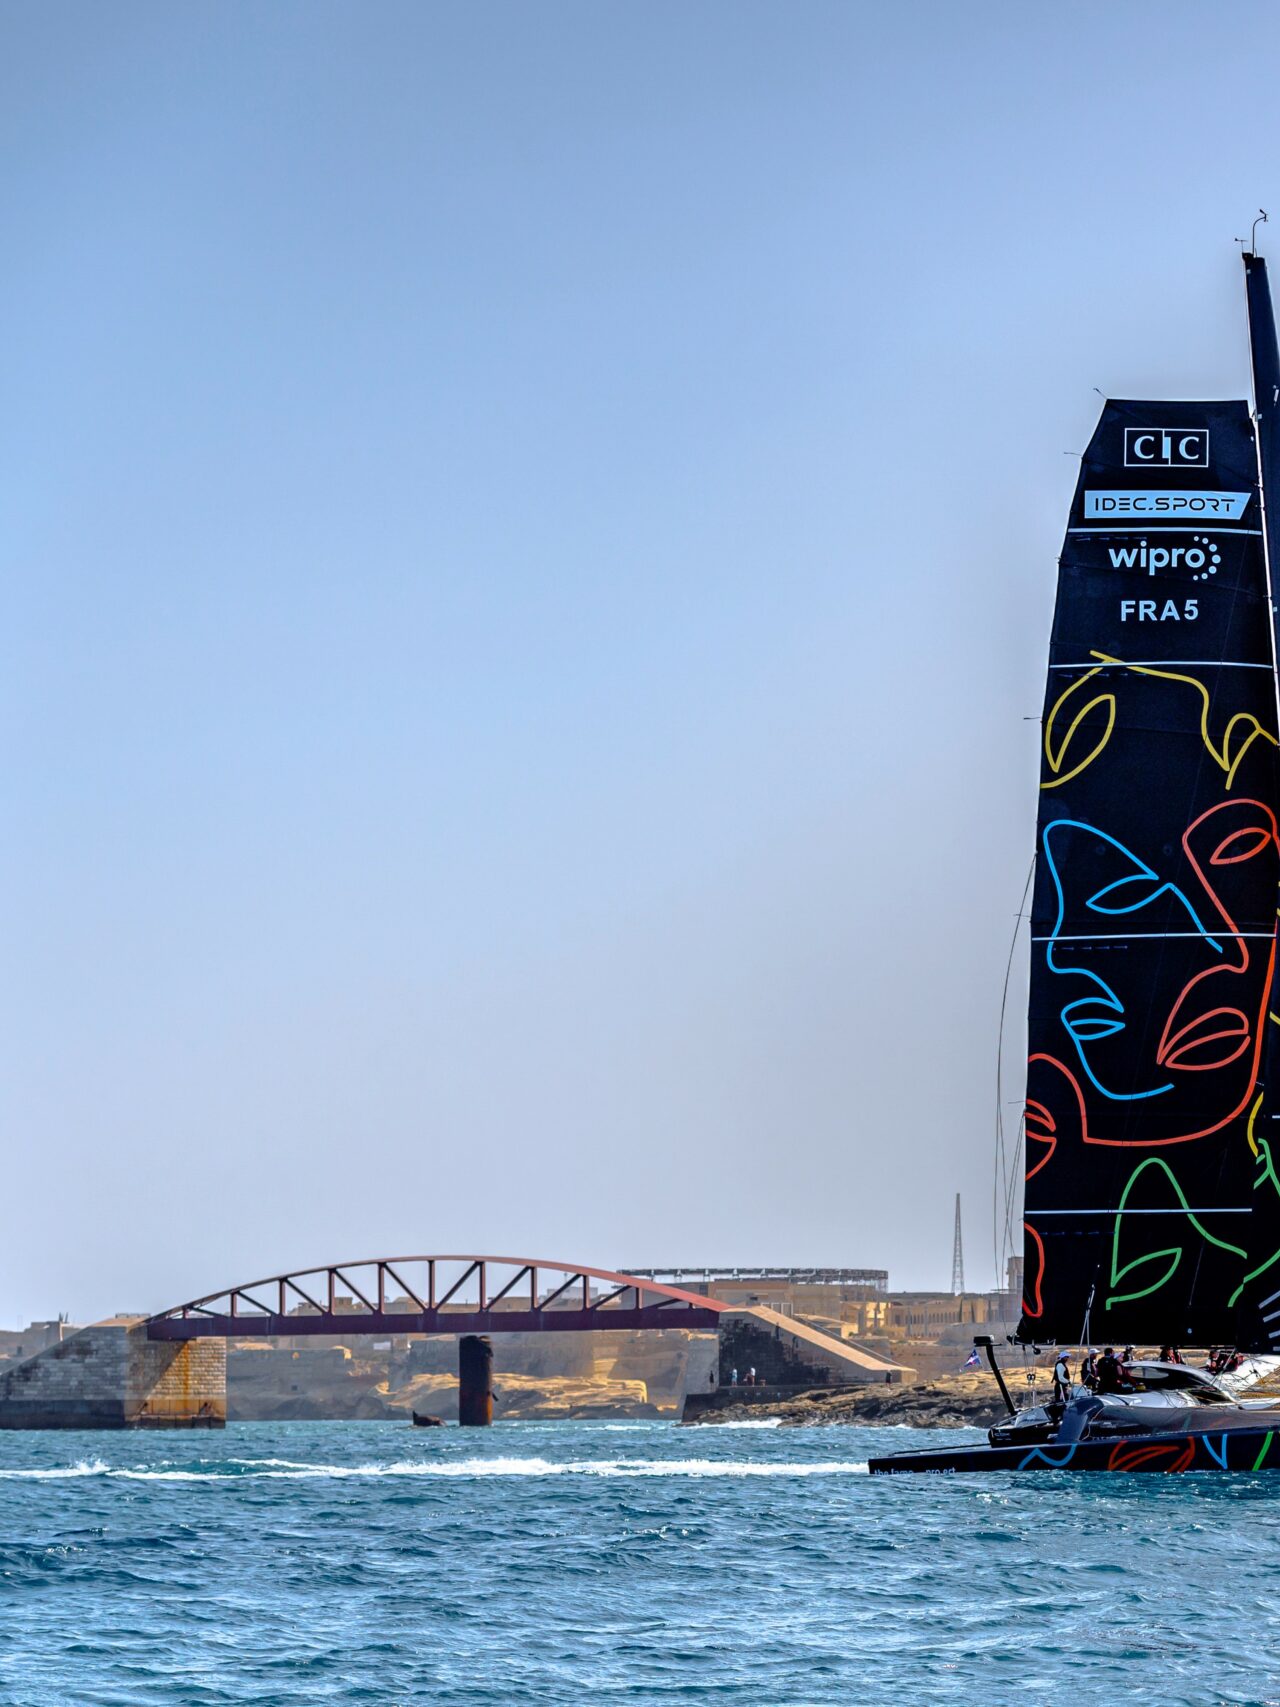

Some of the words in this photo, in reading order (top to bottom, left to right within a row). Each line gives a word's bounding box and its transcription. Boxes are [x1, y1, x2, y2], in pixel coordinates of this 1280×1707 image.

[1134, 435, 1200, 460] CIC
[1095, 497, 1236, 512] IDEC.SPORT
[1108, 540, 1206, 576] wipro
